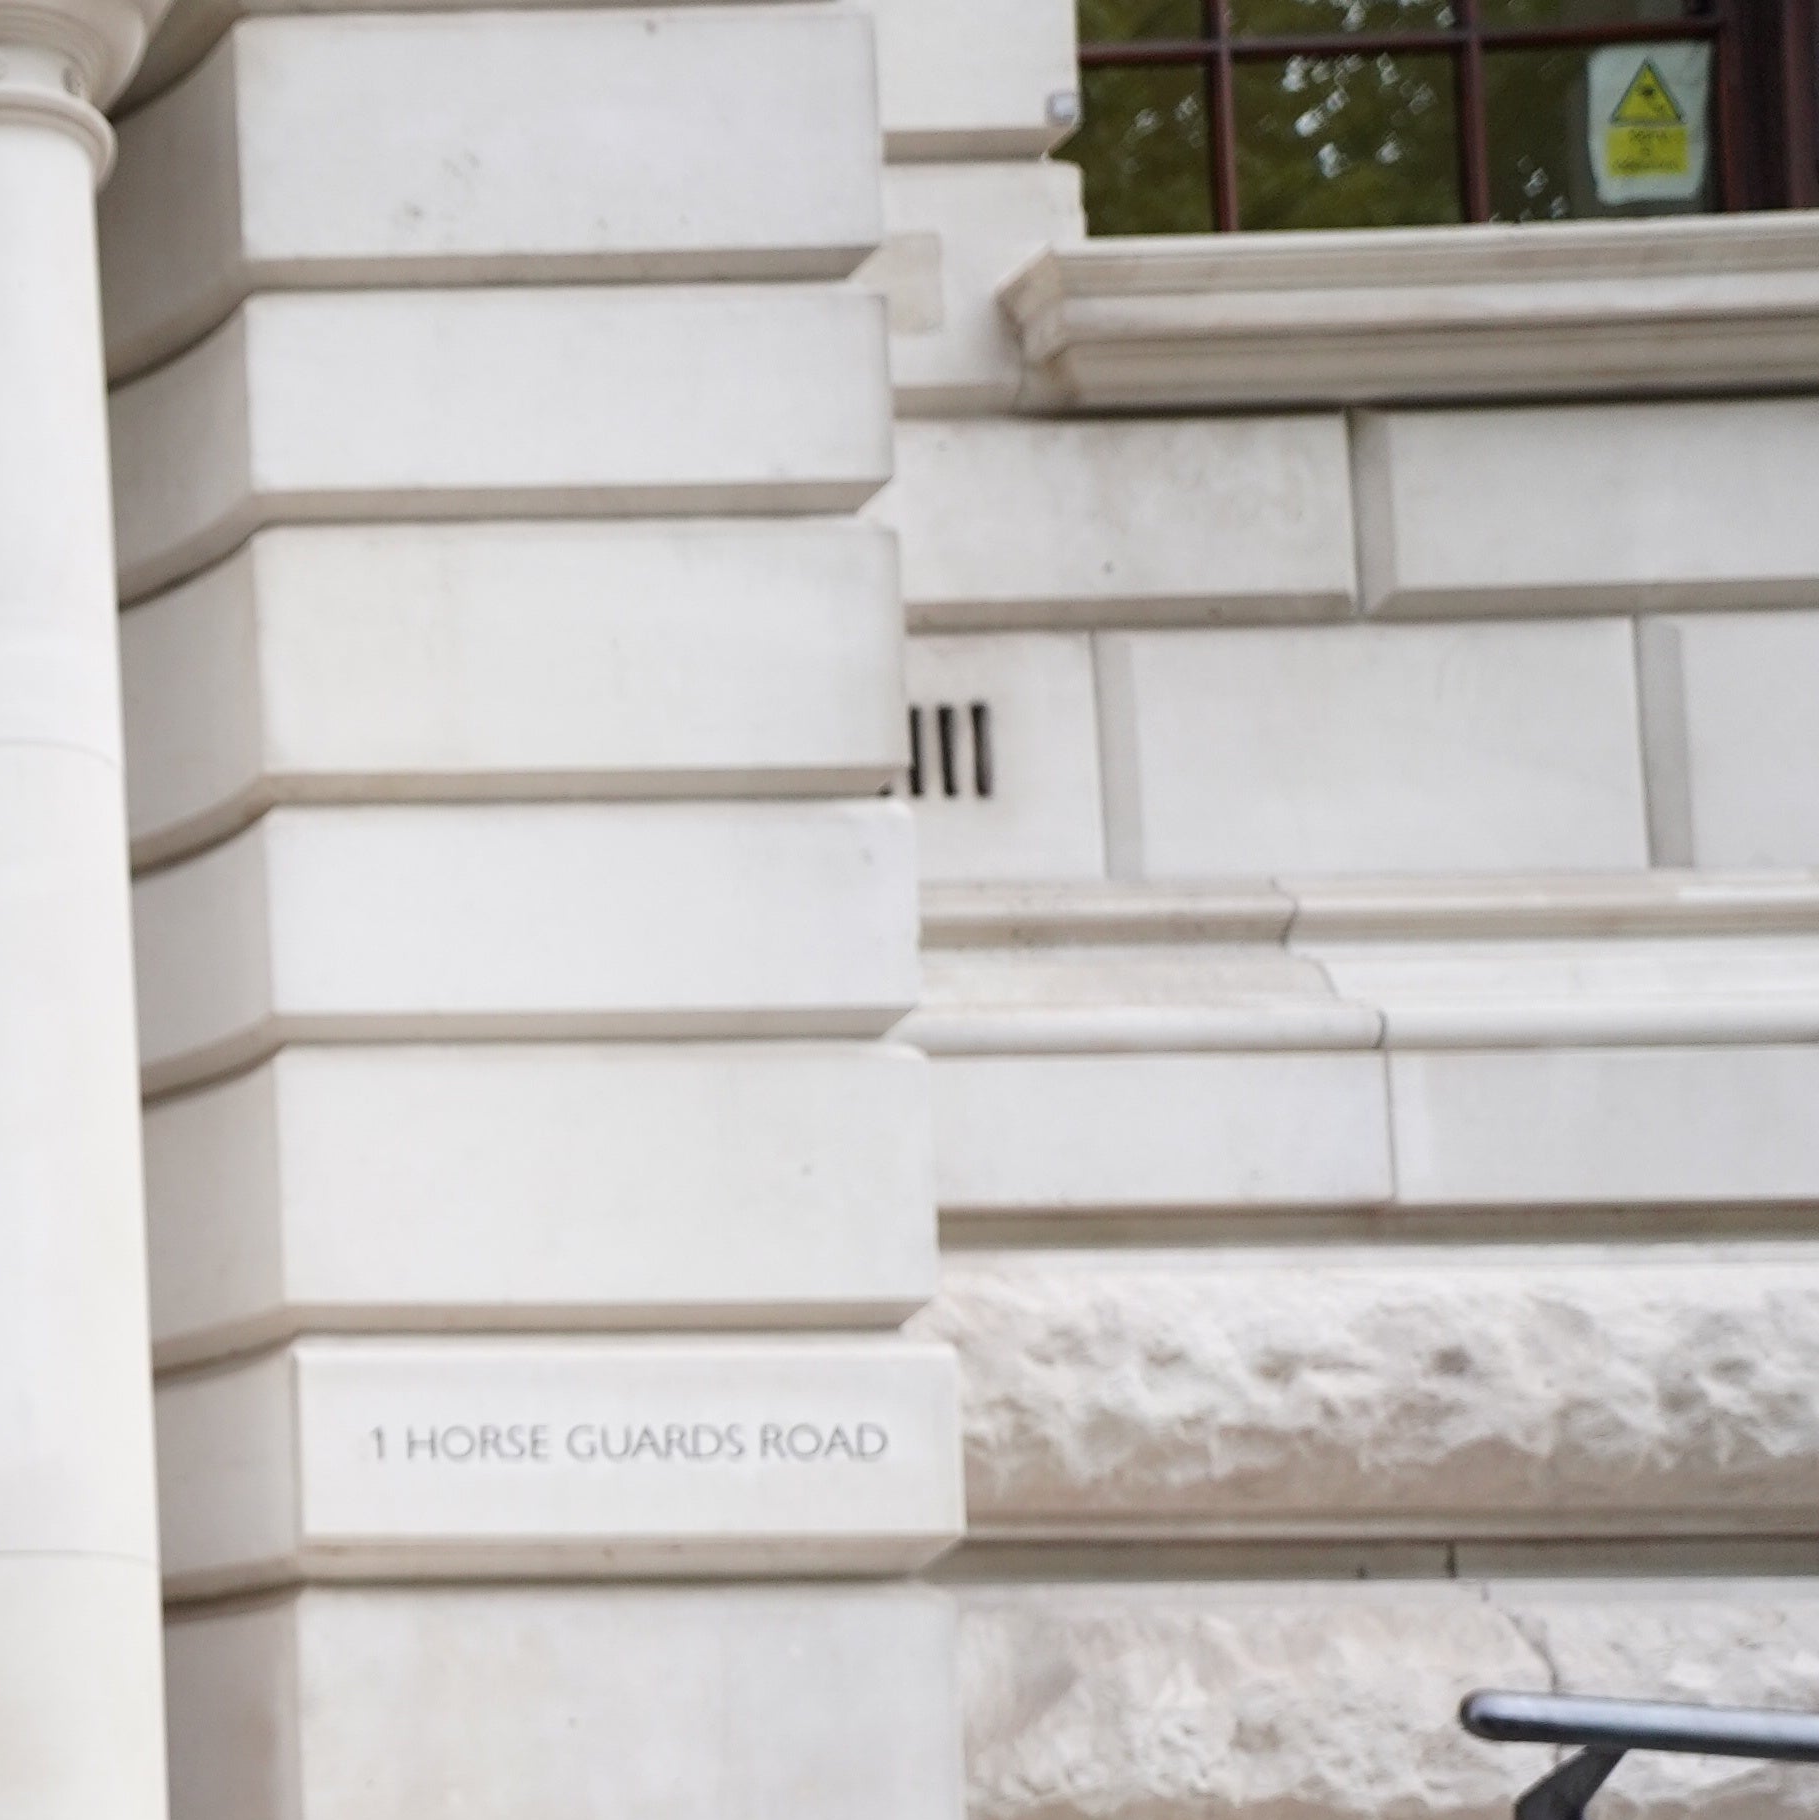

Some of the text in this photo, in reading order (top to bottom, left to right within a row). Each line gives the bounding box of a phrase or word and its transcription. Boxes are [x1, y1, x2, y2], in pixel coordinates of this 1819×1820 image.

[369, 1422, 889, 1462] 1 HORSE GUARDS ROAD
